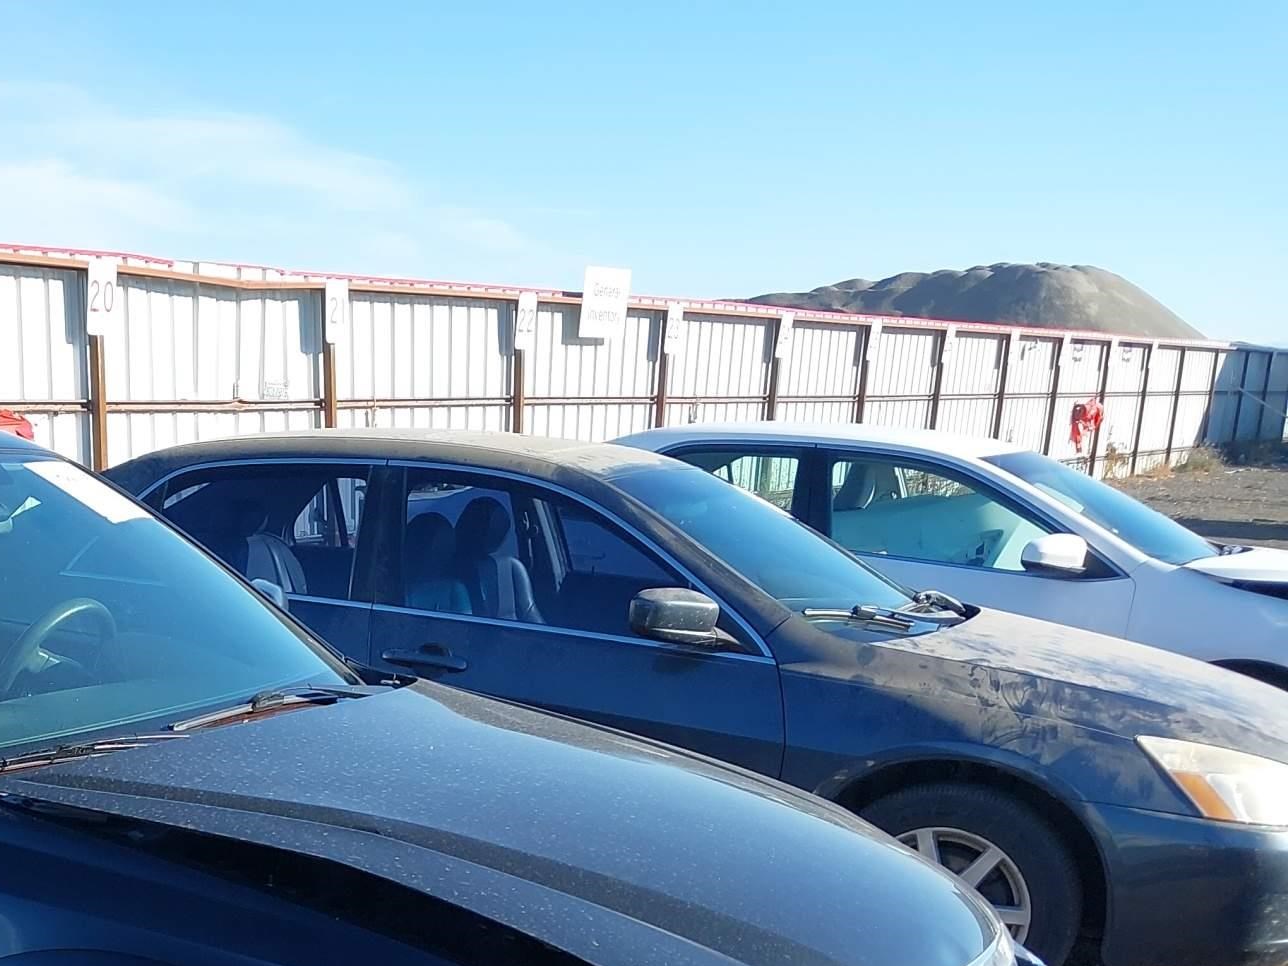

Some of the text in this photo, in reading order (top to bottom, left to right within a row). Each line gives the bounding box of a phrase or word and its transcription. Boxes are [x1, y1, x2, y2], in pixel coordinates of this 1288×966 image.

[90, 279, 114, 313] 20
[329, 297, 345, 325] 21
[517, 308, 536, 333] 22
